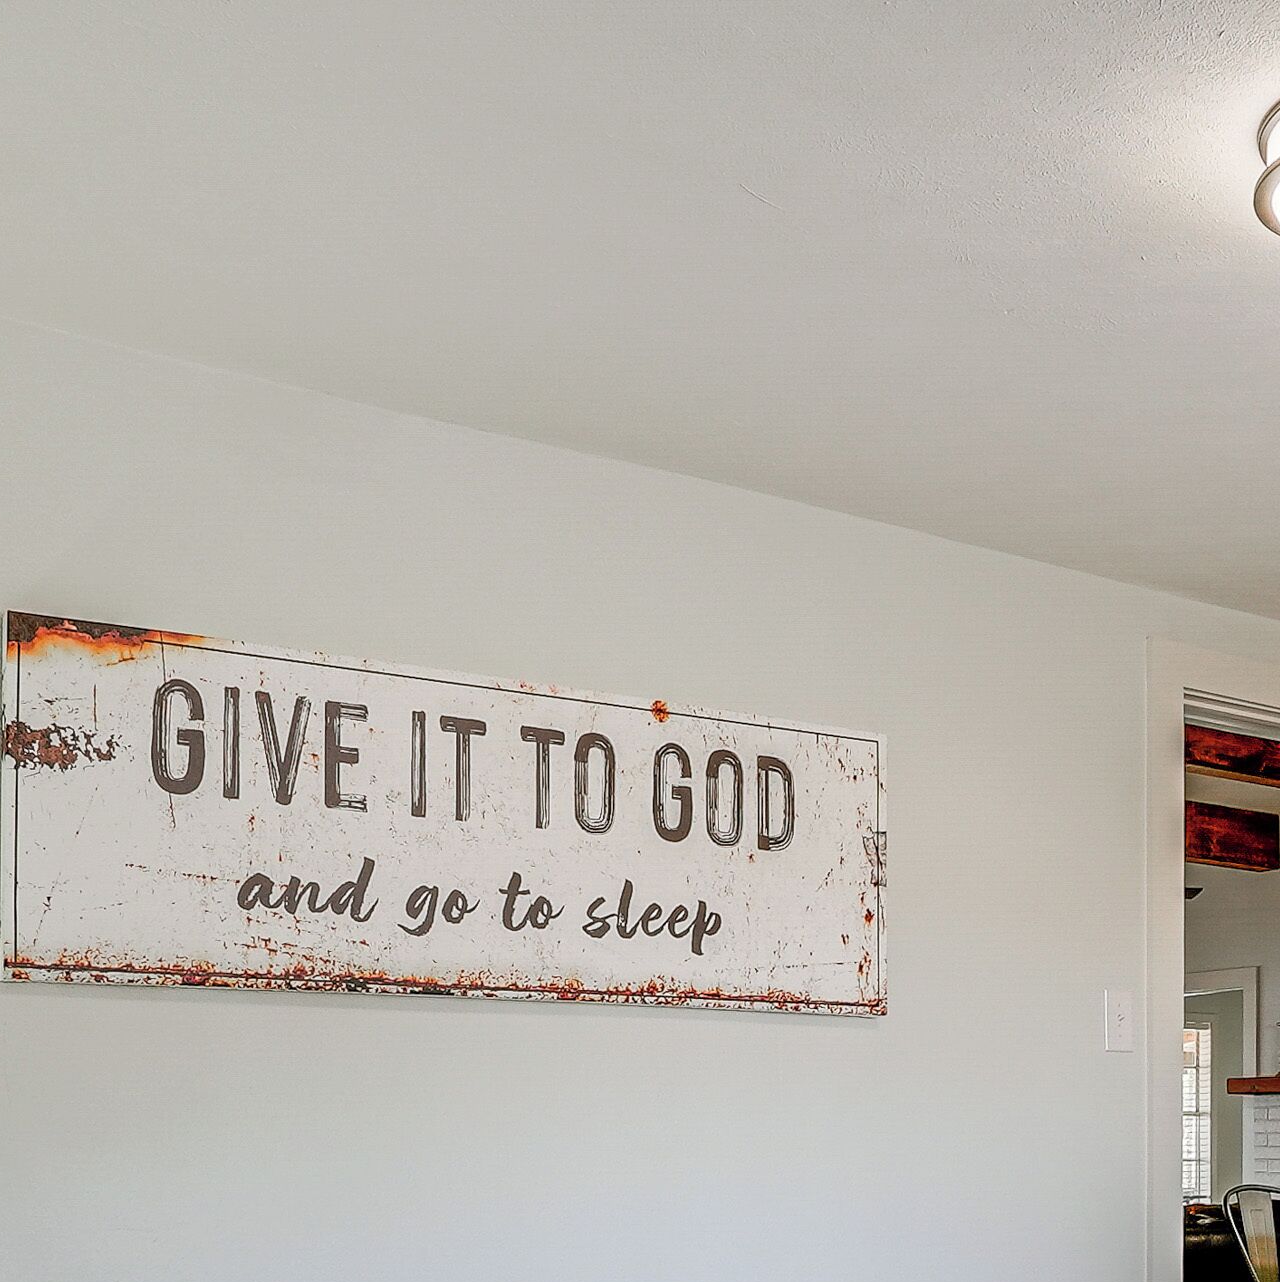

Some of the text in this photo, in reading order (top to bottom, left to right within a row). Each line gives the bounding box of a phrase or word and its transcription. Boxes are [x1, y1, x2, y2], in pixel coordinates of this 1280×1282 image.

[150, 678, 796, 852] GIVE IT TO GOD
[236, 856, 723, 956] and go to sleep
